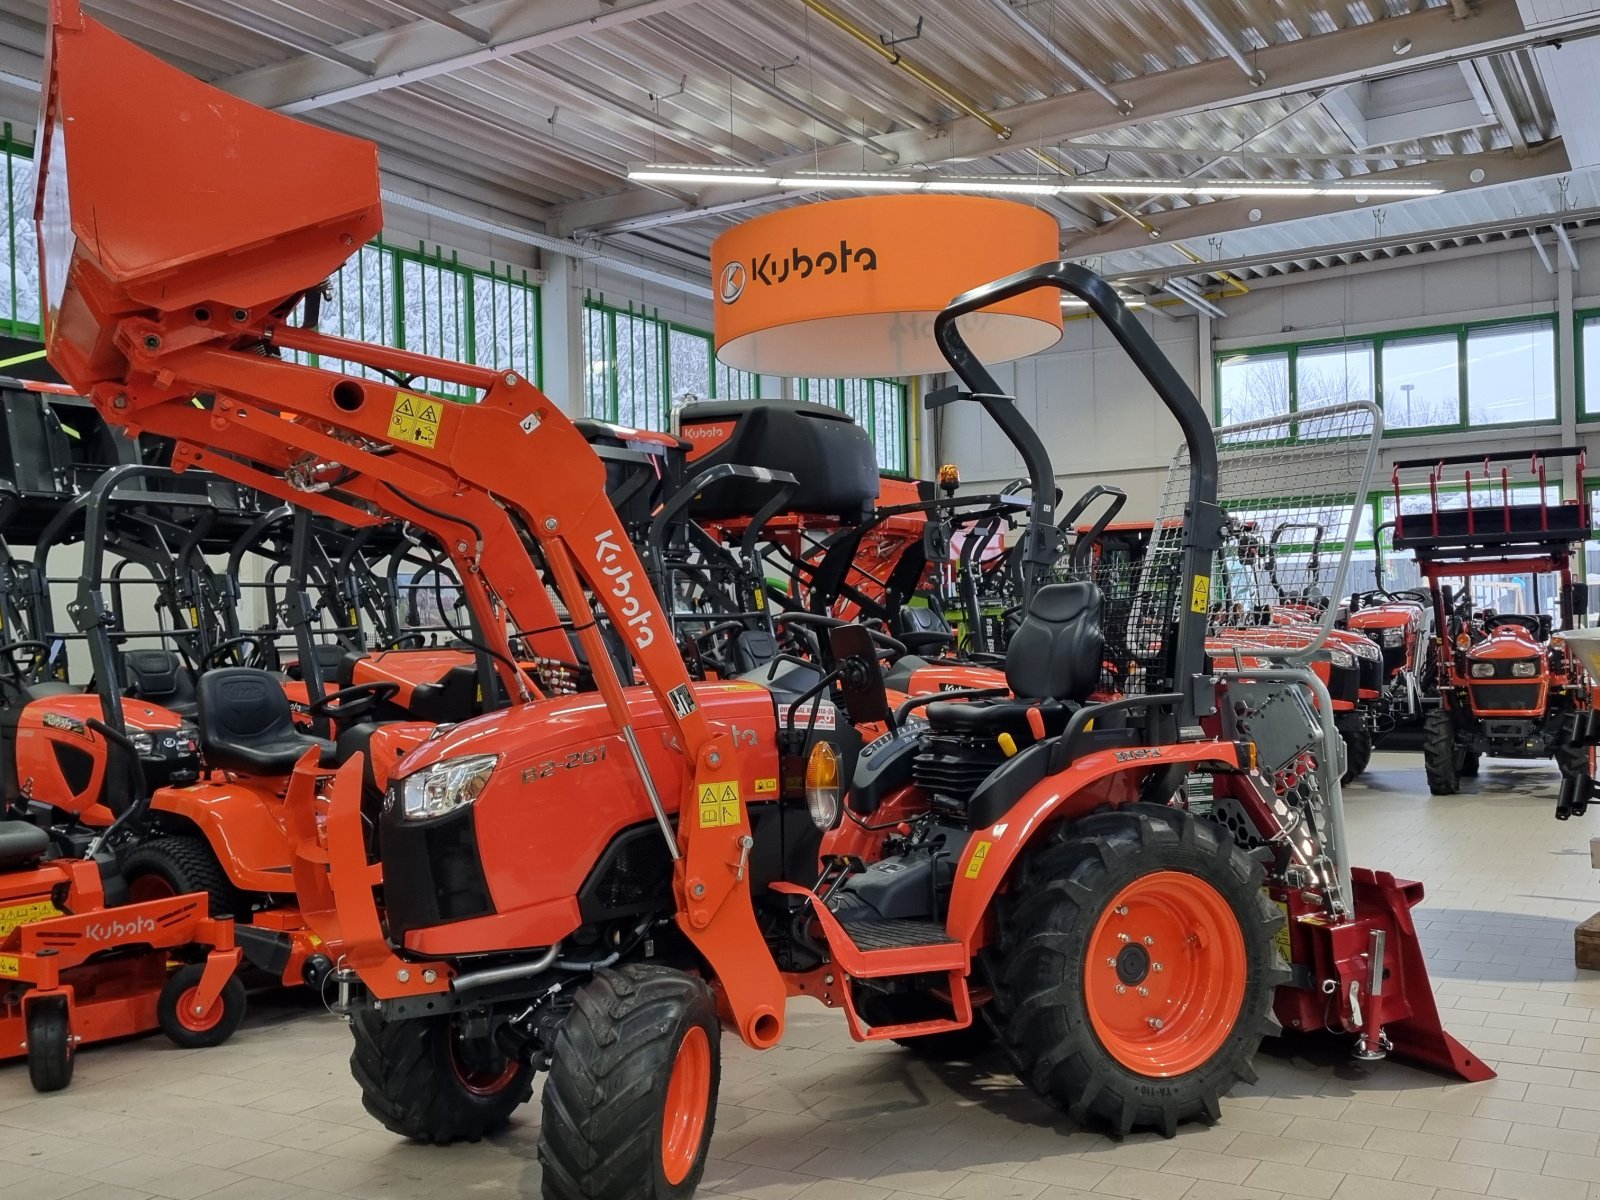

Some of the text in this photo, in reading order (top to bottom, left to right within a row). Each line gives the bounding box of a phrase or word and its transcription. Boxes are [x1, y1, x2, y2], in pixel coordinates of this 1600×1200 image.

[752, 240, 877, 286] Kubota
[684, 426, 723, 439] Kubota
[594, 529, 654, 649] Kubota
[521, 745, 607, 785] B2-261
[1114, 748, 1162, 763] HST
[85, 916, 156, 941] Kubota
